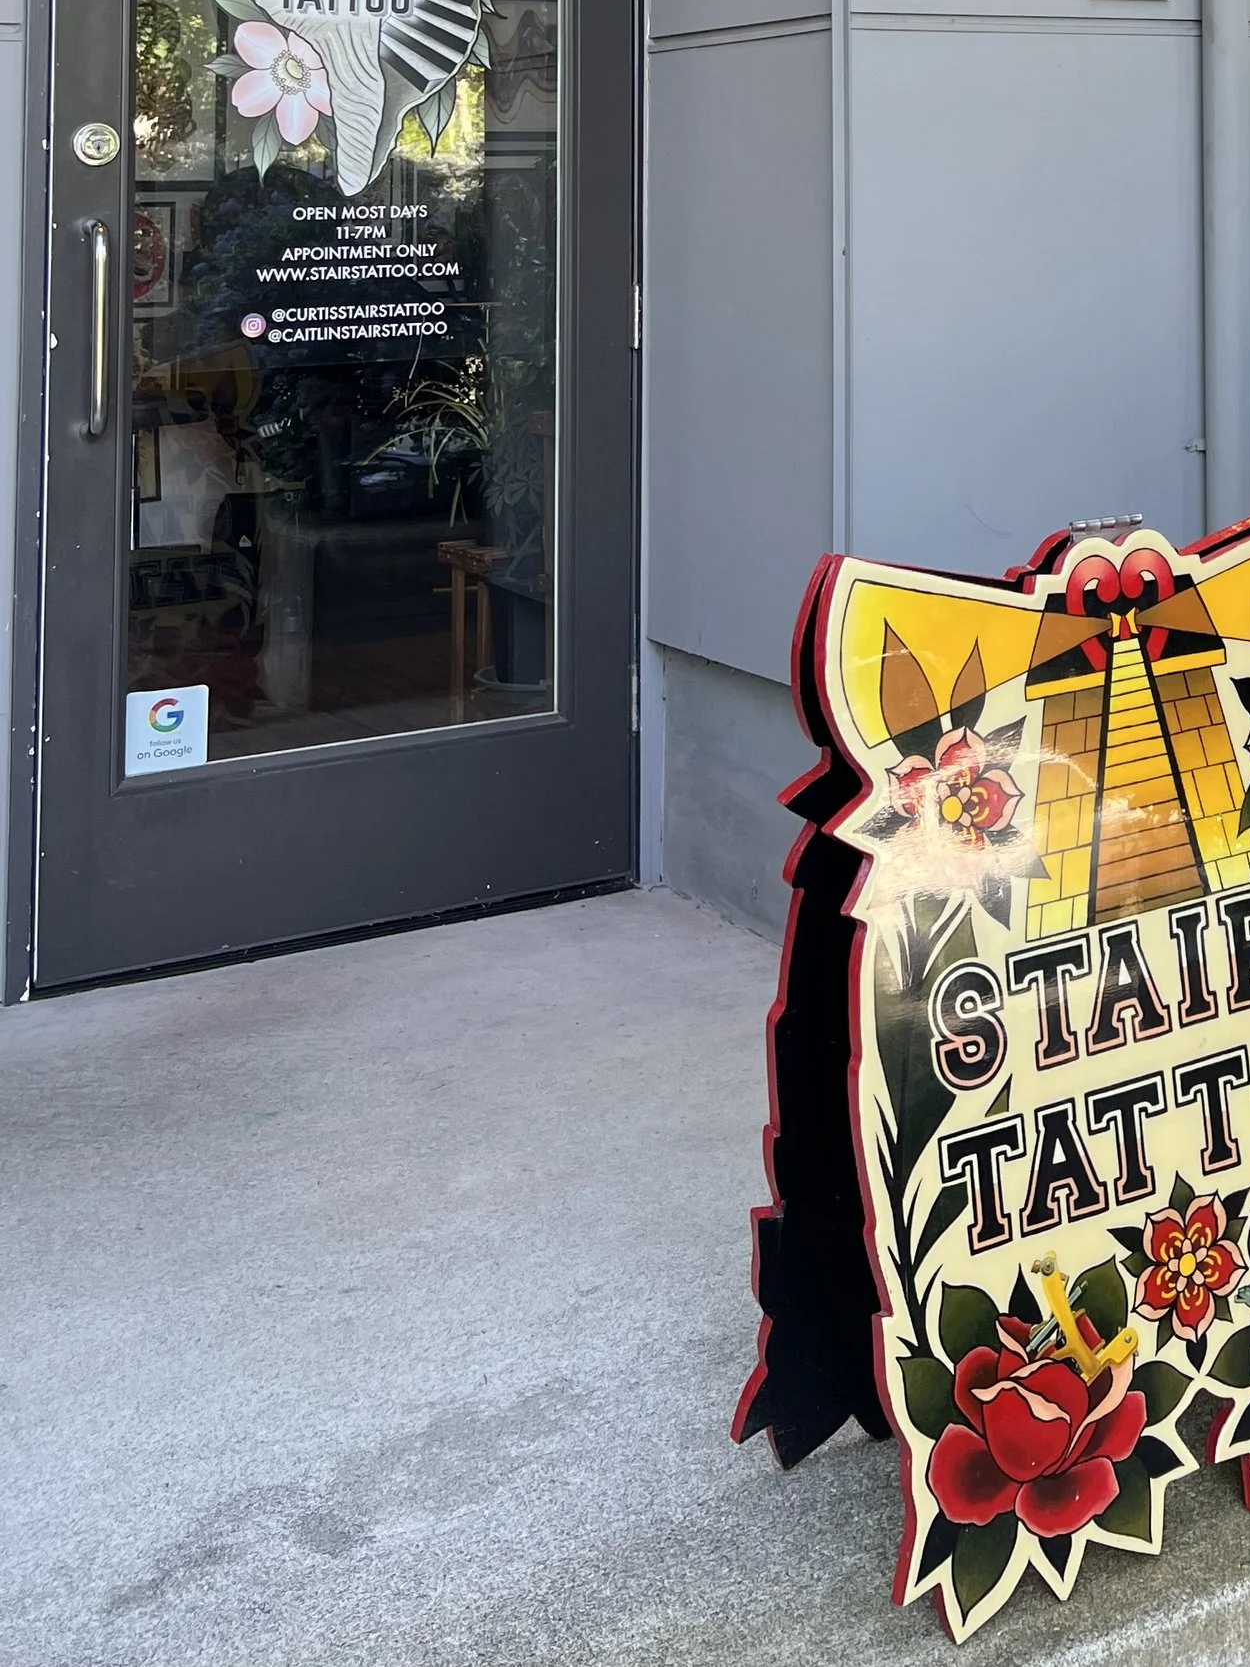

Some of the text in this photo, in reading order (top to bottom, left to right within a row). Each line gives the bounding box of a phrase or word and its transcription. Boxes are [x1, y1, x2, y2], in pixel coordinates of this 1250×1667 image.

[292, 205, 428, 221] OPEN MOST DAYS
[335, 226, 386, 240] 11-7PM
[281, 243, 437, 261] APPOINTMENT ONLY
[256, 262, 460, 282] WWW.STAIRSTATTOO.COM
[271, 301, 445, 323] @CURTISSTAIRSTATTOO
[268, 321, 448, 343] @CAITLINSTAIRSTATTOO
[136, 745, 193, 760] on Google
